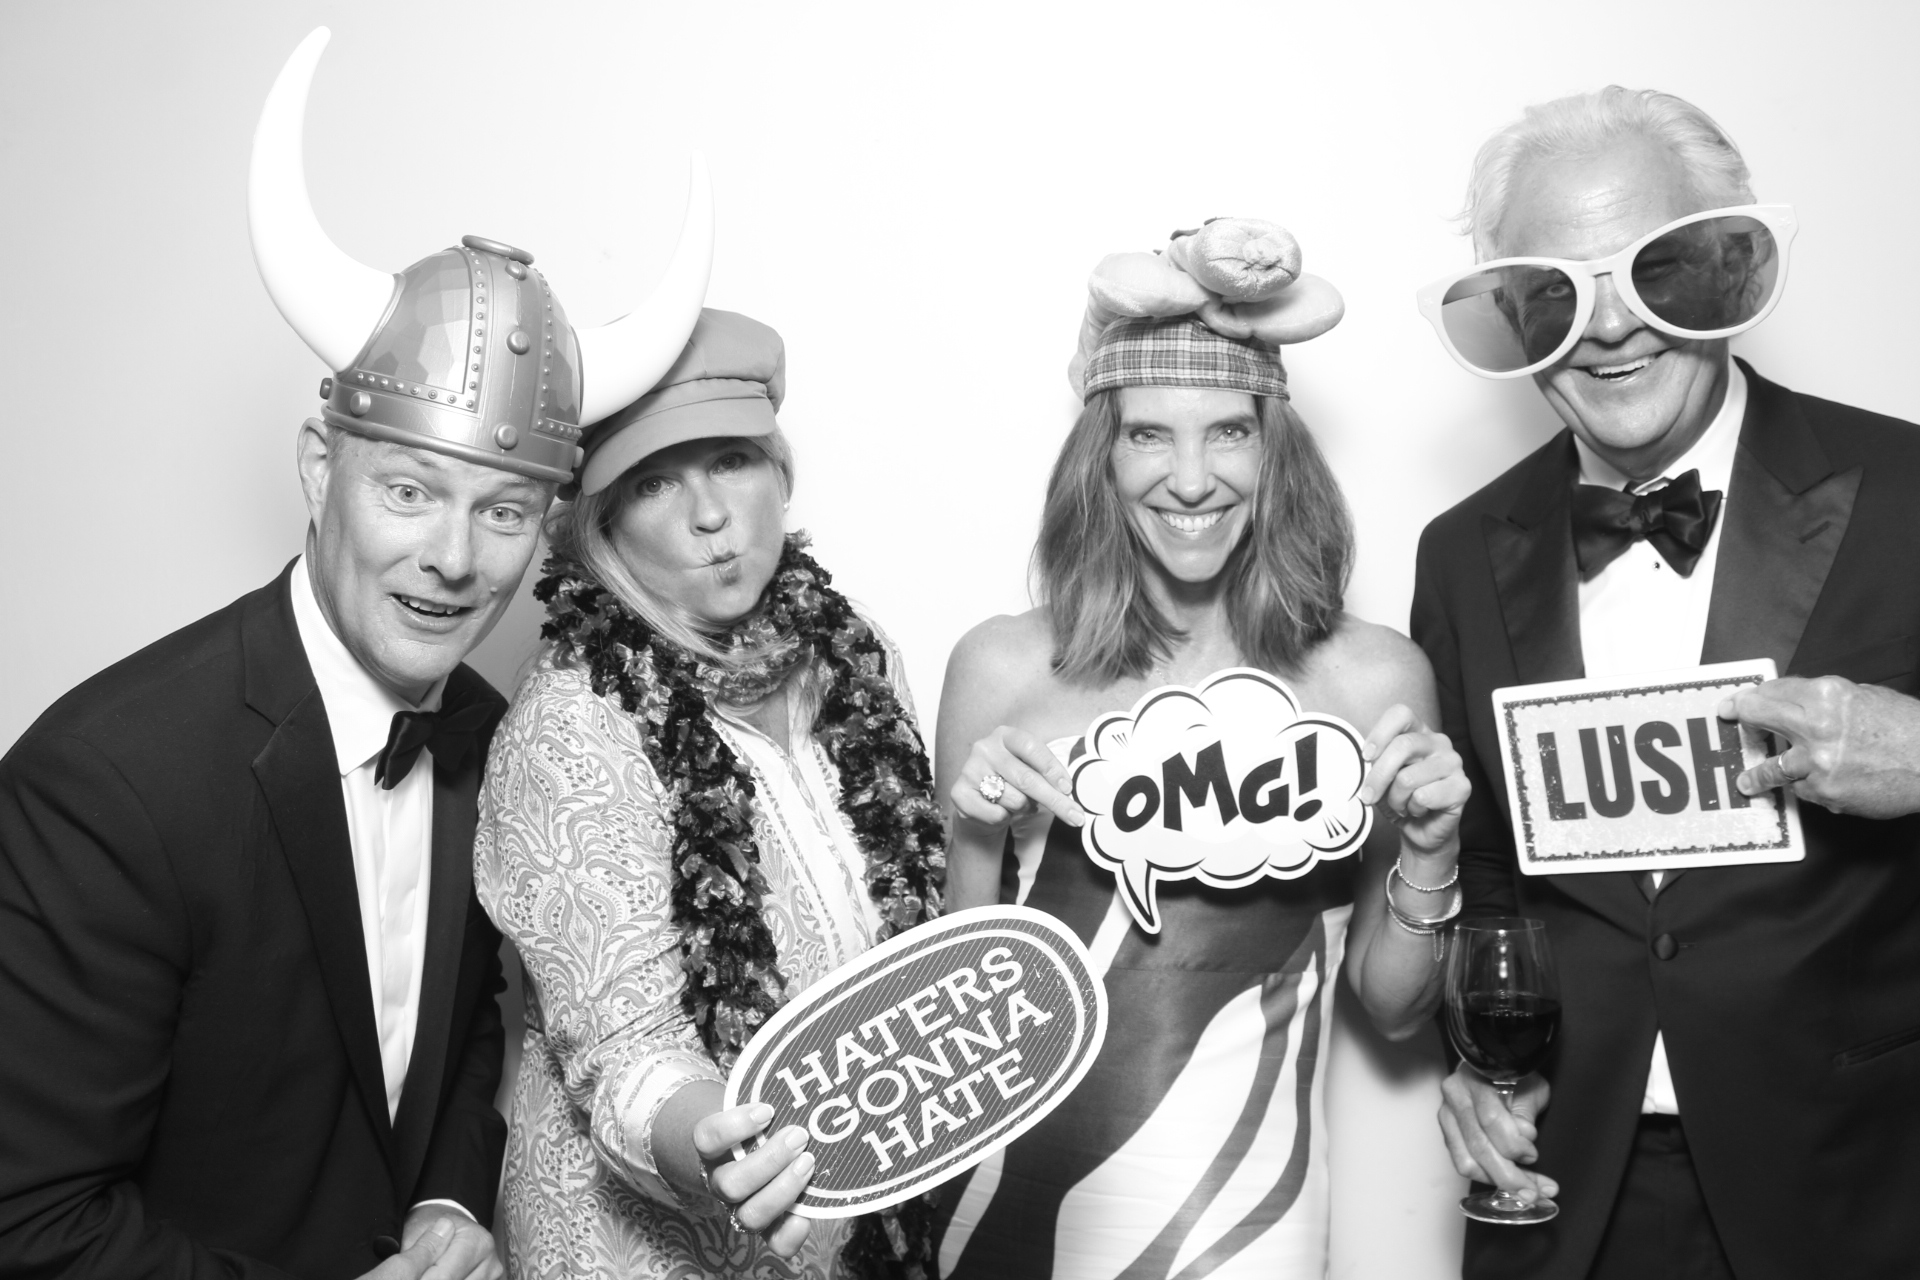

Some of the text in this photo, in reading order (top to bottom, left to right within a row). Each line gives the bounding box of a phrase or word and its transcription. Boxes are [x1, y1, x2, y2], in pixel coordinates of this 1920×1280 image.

[1112, 731, 1323, 833] OMG!
[1537, 715, 1752, 822] LUSH
[775, 946, 1024, 1110] HATERS
[808, 989, 1054, 1144] GONNA
[861, 1048, 1036, 1172] HATE
